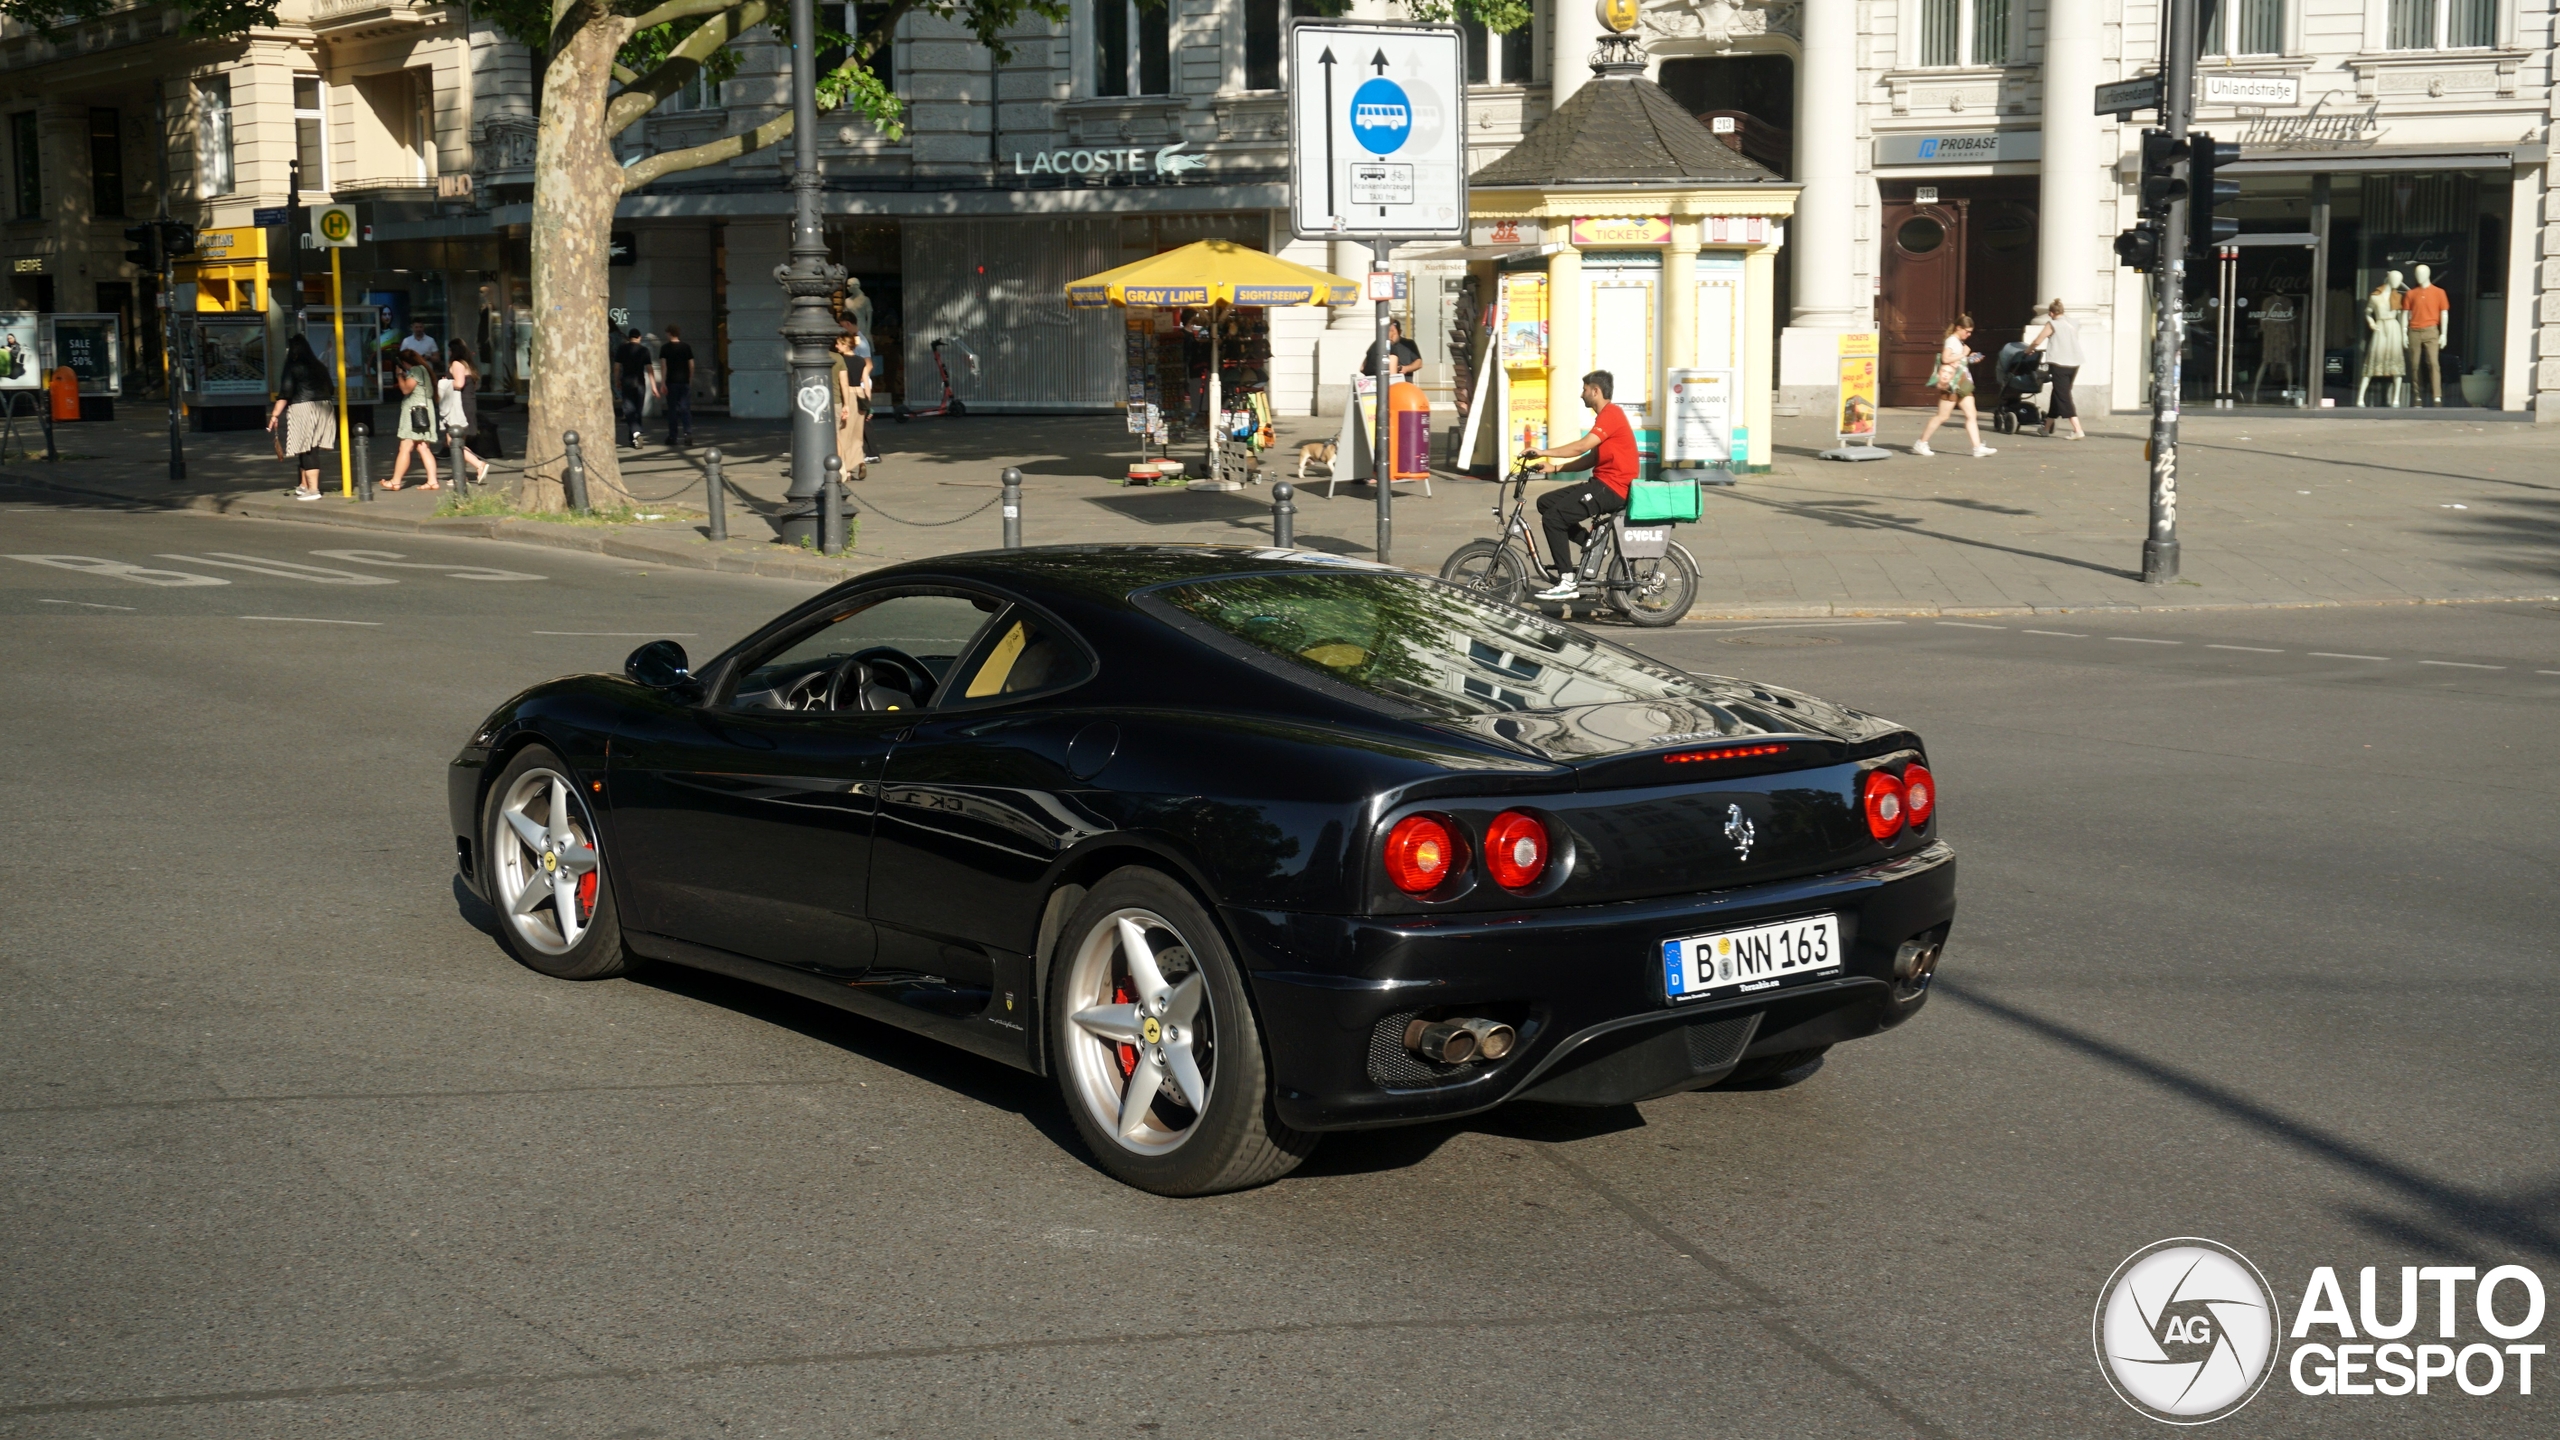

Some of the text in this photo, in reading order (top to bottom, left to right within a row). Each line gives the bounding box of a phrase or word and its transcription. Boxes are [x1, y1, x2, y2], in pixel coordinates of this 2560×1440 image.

[2211, 80, 2291, 99] Uhlandstraße
[1716, 118, 1732, 130] 213
[1939, 136, 1999, 150] PROBASE
[1015, 148, 1146, 176] LACOSTE
[1353, 183, 1411, 192] Krankenfahrzeuge
[1369, 193, 1383, 201] TAXI
[1919, 188, 1935, 200] 213
[328, 216, 343, 234] H
[1595, 229, 1650, 240] TICKETS
[1126, 290, 1207, 303] GRAY LINE
[1239, 290, 1309, 301] SIGHTSEEING
[69, 339, 90, 349] SALE
[69, 356, 93, 366] -50%
[1624, 530, 1663, 542] CYCLE
[3, 549, 549, 587] BUS
[1696, 924, 1828, 984] B NN 163
[1671, 973, 1680, 986] D
